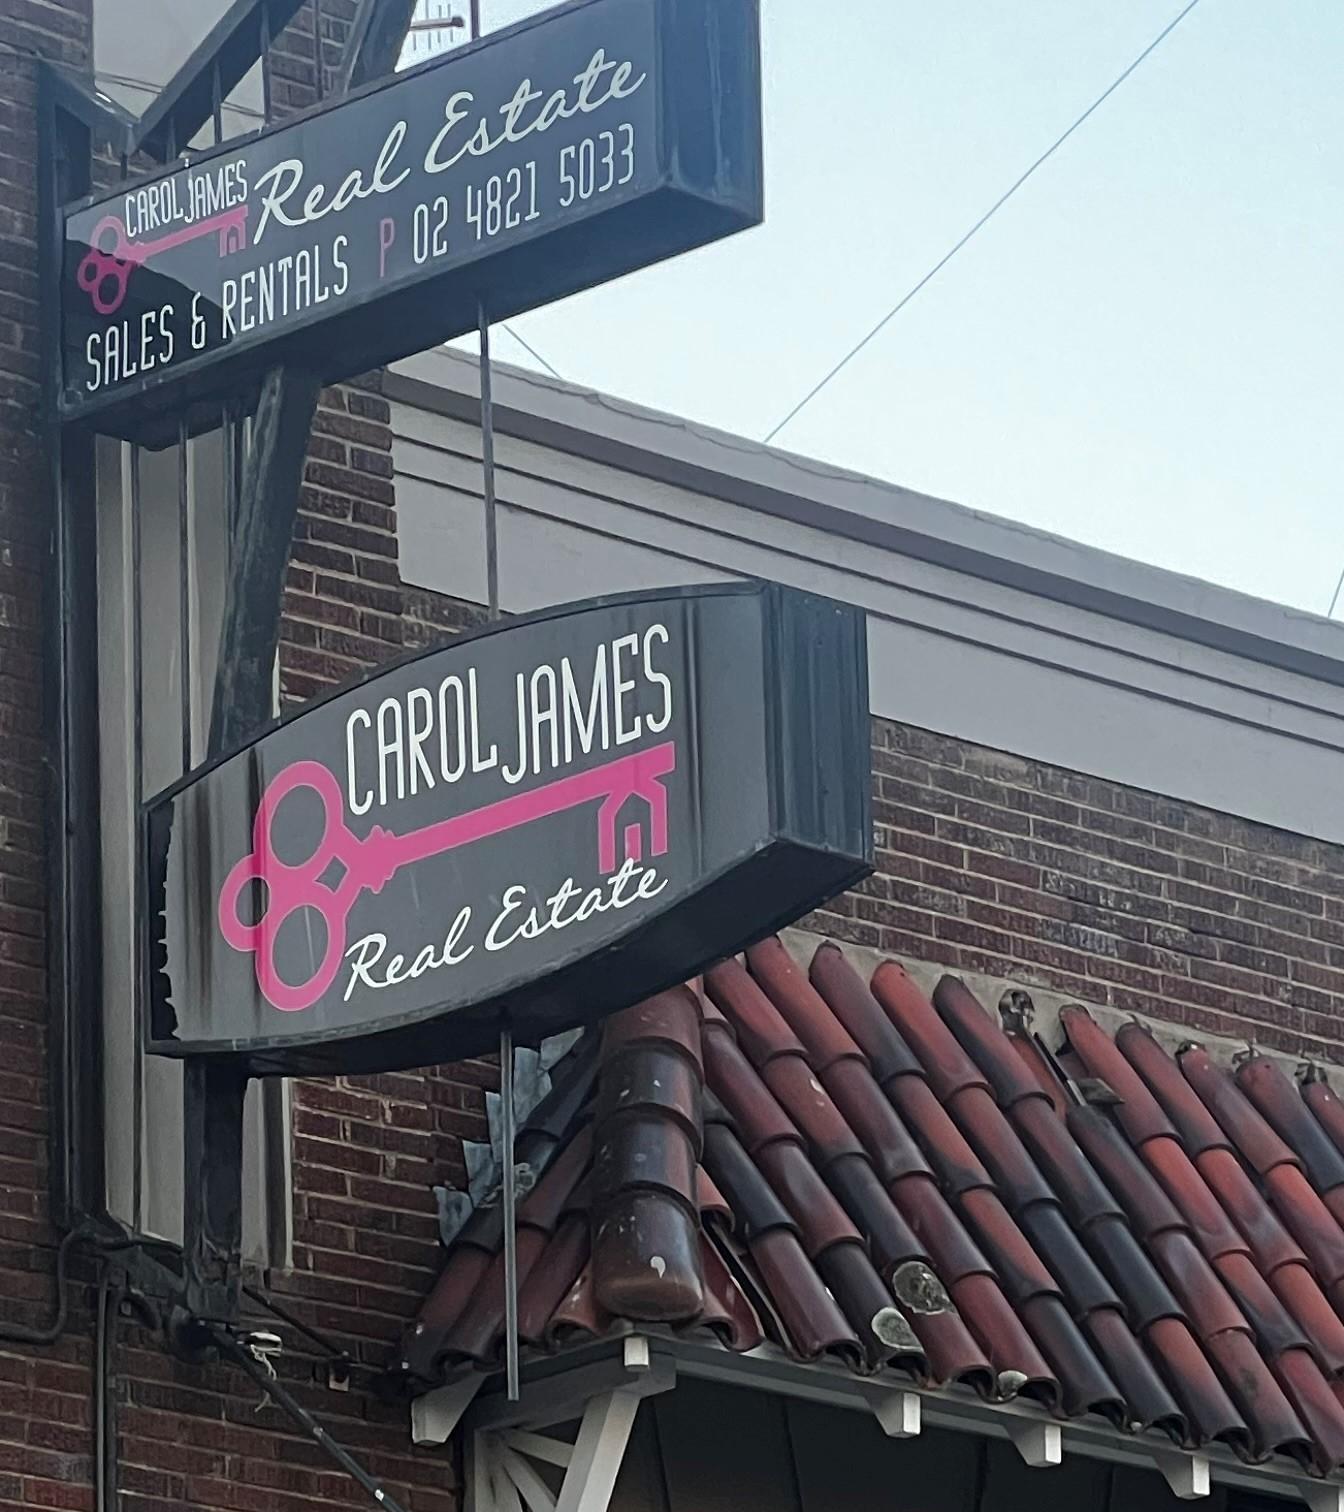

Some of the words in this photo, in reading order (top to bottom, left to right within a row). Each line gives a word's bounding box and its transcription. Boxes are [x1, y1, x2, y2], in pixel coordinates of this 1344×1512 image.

[124, 172, 182, 238] CAROL
[183, 159, 249, 224] JAMES
[253, 120, 411, 246] Real
[422, 48, 647, 174] Estate
[85, 304, 174, 393] SALES
[191, 291, 206, 350] &
[221, 235, 348, 340] RENTALS
[378, 217, 396, 278] P
[412, 196, 449, 264] 02
[465, 159, 539, 243] 4821
[558, 122, 636, 208] 5033
[345, 666, 499, 815] CAROL
[500, 622, 675, 785] JAMES
[342, 905, 475, 1003] Real
[484, 856, 669, 953] Estate
